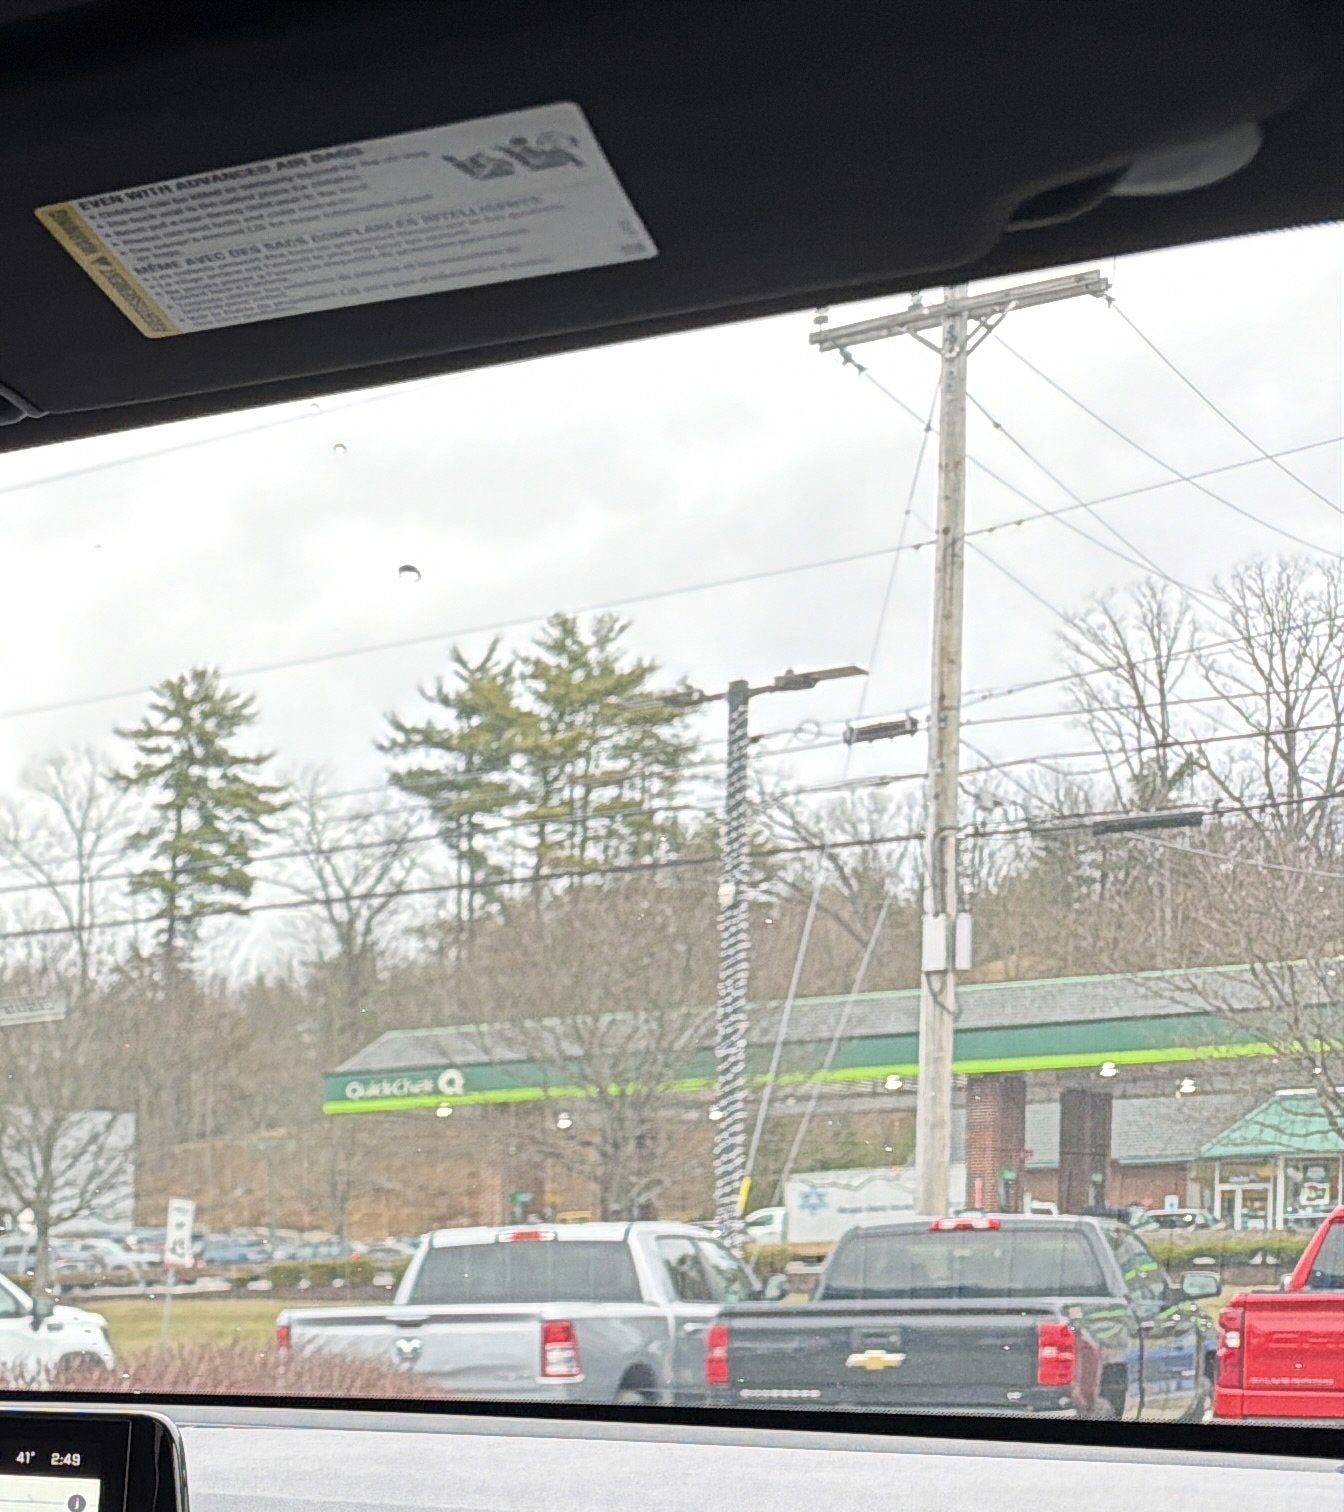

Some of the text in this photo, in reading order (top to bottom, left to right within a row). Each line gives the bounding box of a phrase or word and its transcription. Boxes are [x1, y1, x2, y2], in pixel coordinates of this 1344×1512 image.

[125, 184, 173, 202] WITH
[176, 164, 272, 191] ADVANCED
[50, 1453, 81, 1466] 2:49
